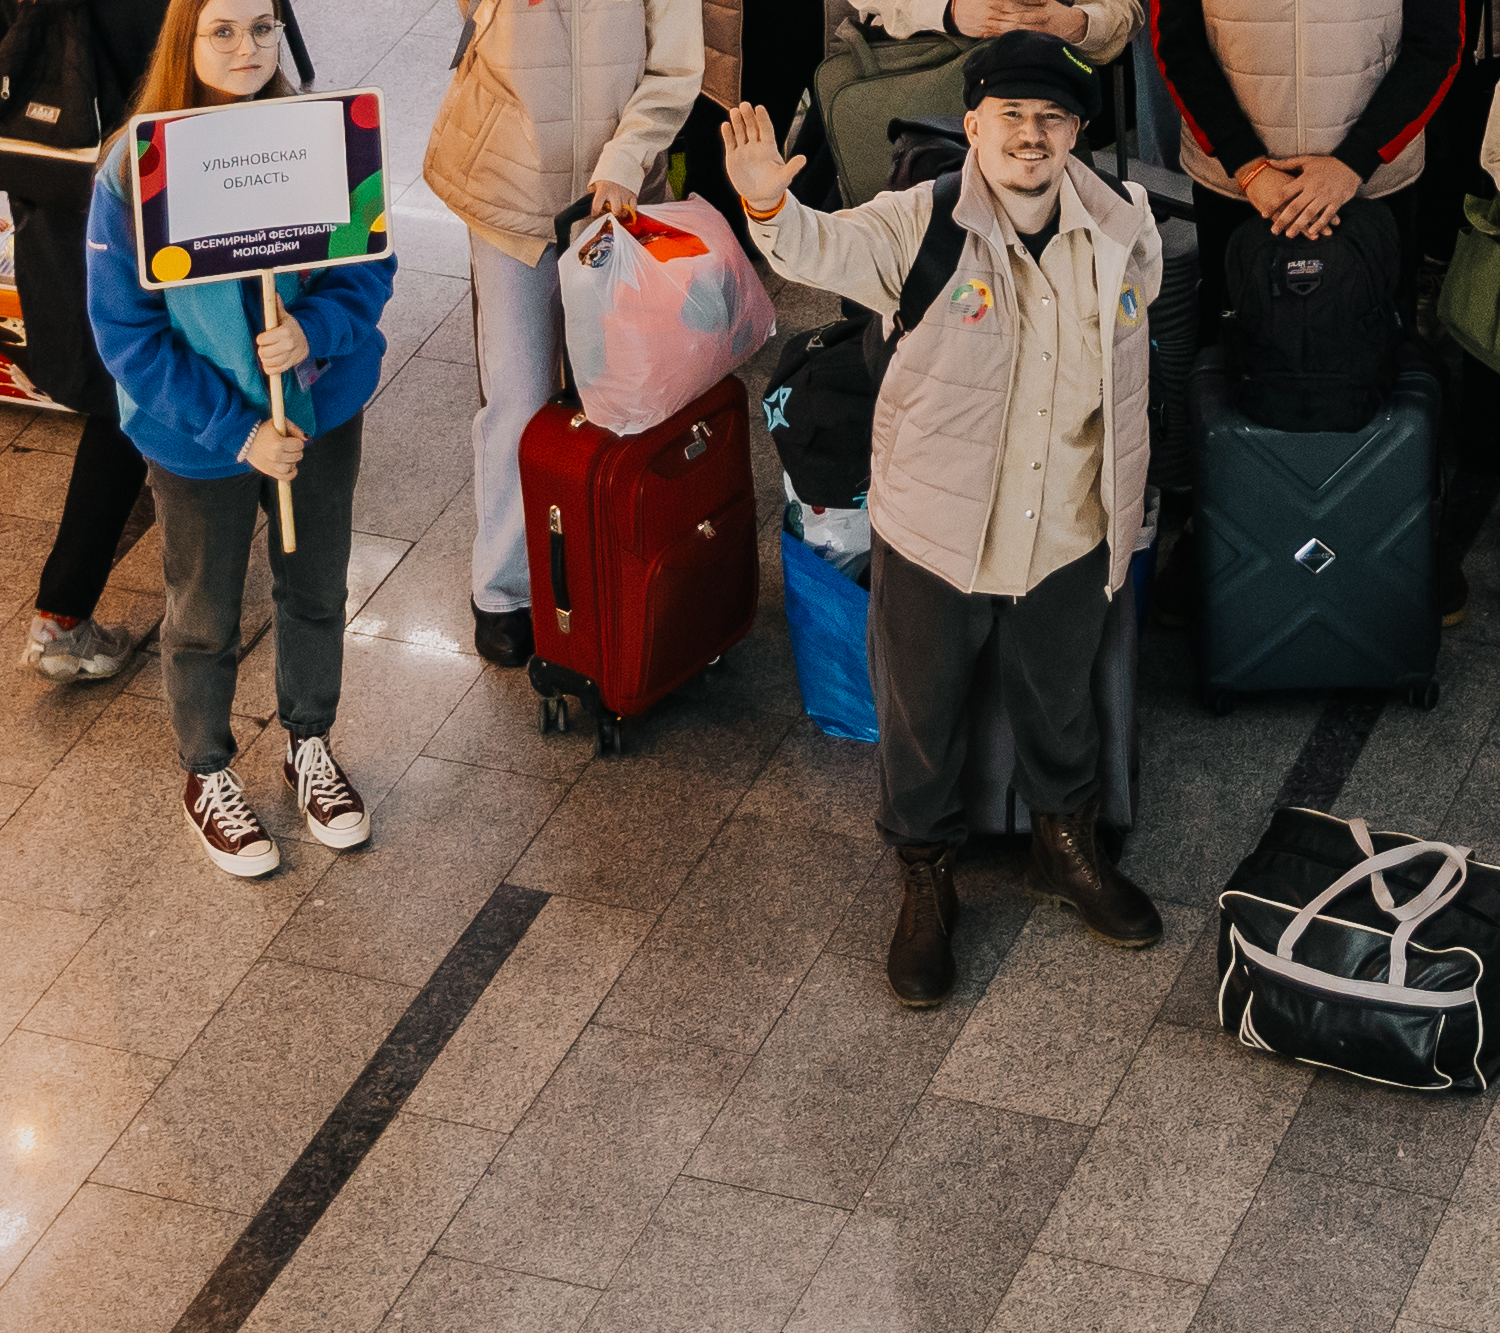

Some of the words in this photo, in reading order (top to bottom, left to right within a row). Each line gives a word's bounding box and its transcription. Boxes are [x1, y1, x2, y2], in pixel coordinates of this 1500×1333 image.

[202, 148, 308, 173] УЛЬЯНОВСКАЯ
[223, 171, 289, 190] ОБЛАСТЬ
[193, 229, 267, 251] ВСЕМИРНЫЙ
[269, 222, 338, 242] ФЕСТИВАЛЬ
[233, 239, 300, 259] МОЛОДЁЖИ
